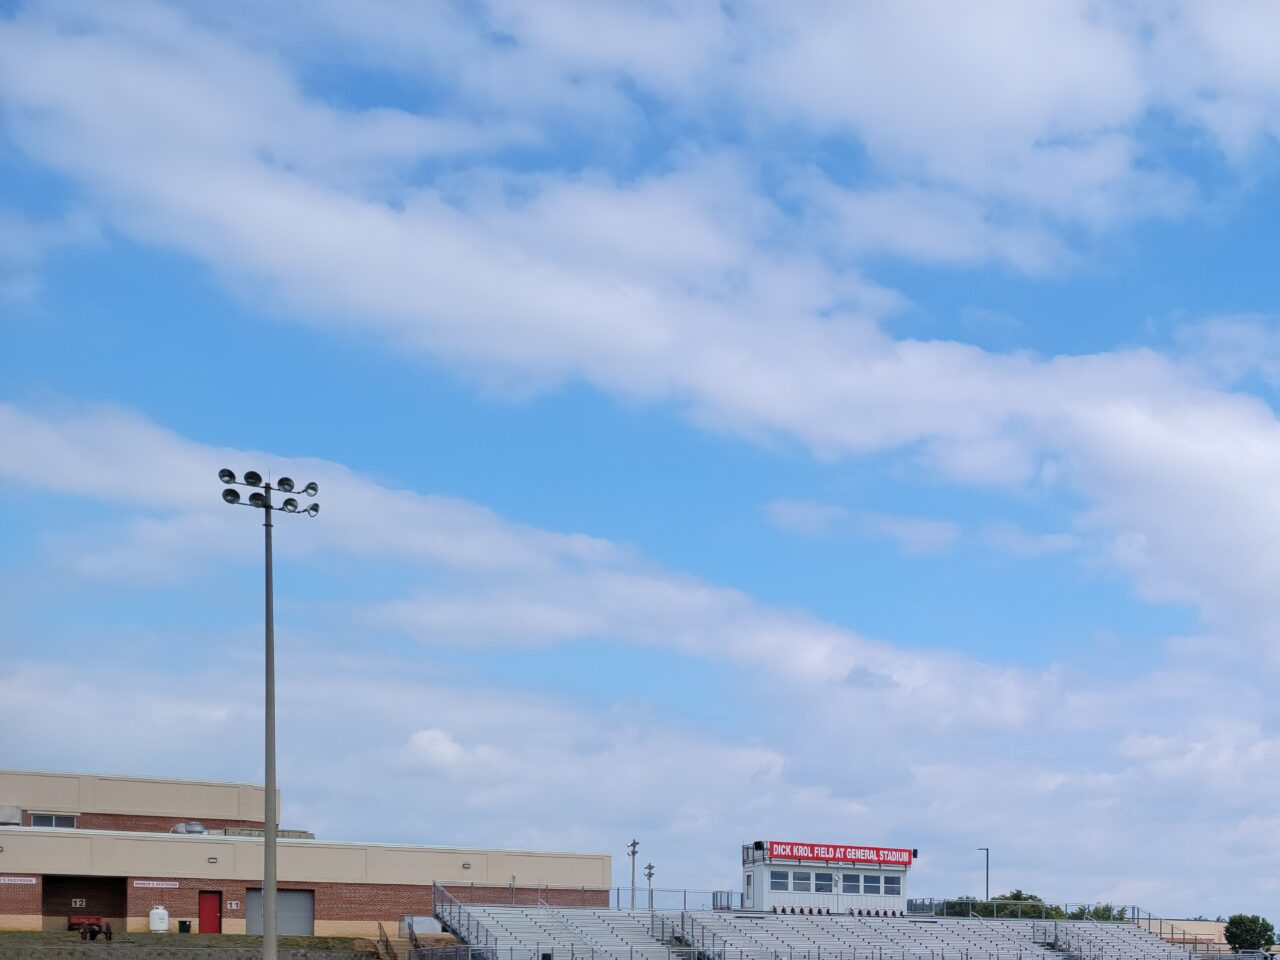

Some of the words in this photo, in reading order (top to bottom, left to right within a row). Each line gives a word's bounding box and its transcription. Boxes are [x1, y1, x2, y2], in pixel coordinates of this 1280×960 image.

[773, 844, 791, 856] DICK
[793, 845, 813, 857] KROL
[814, 846, 834, 858] FIELD
[835, 848, 845, 859] AT
[846, 848, 878, 861] GENERAL
[879, 850, 909, 862] STADIUM
[73, 899, 85, 907] 12
[228, 901, 239, 909] 11
